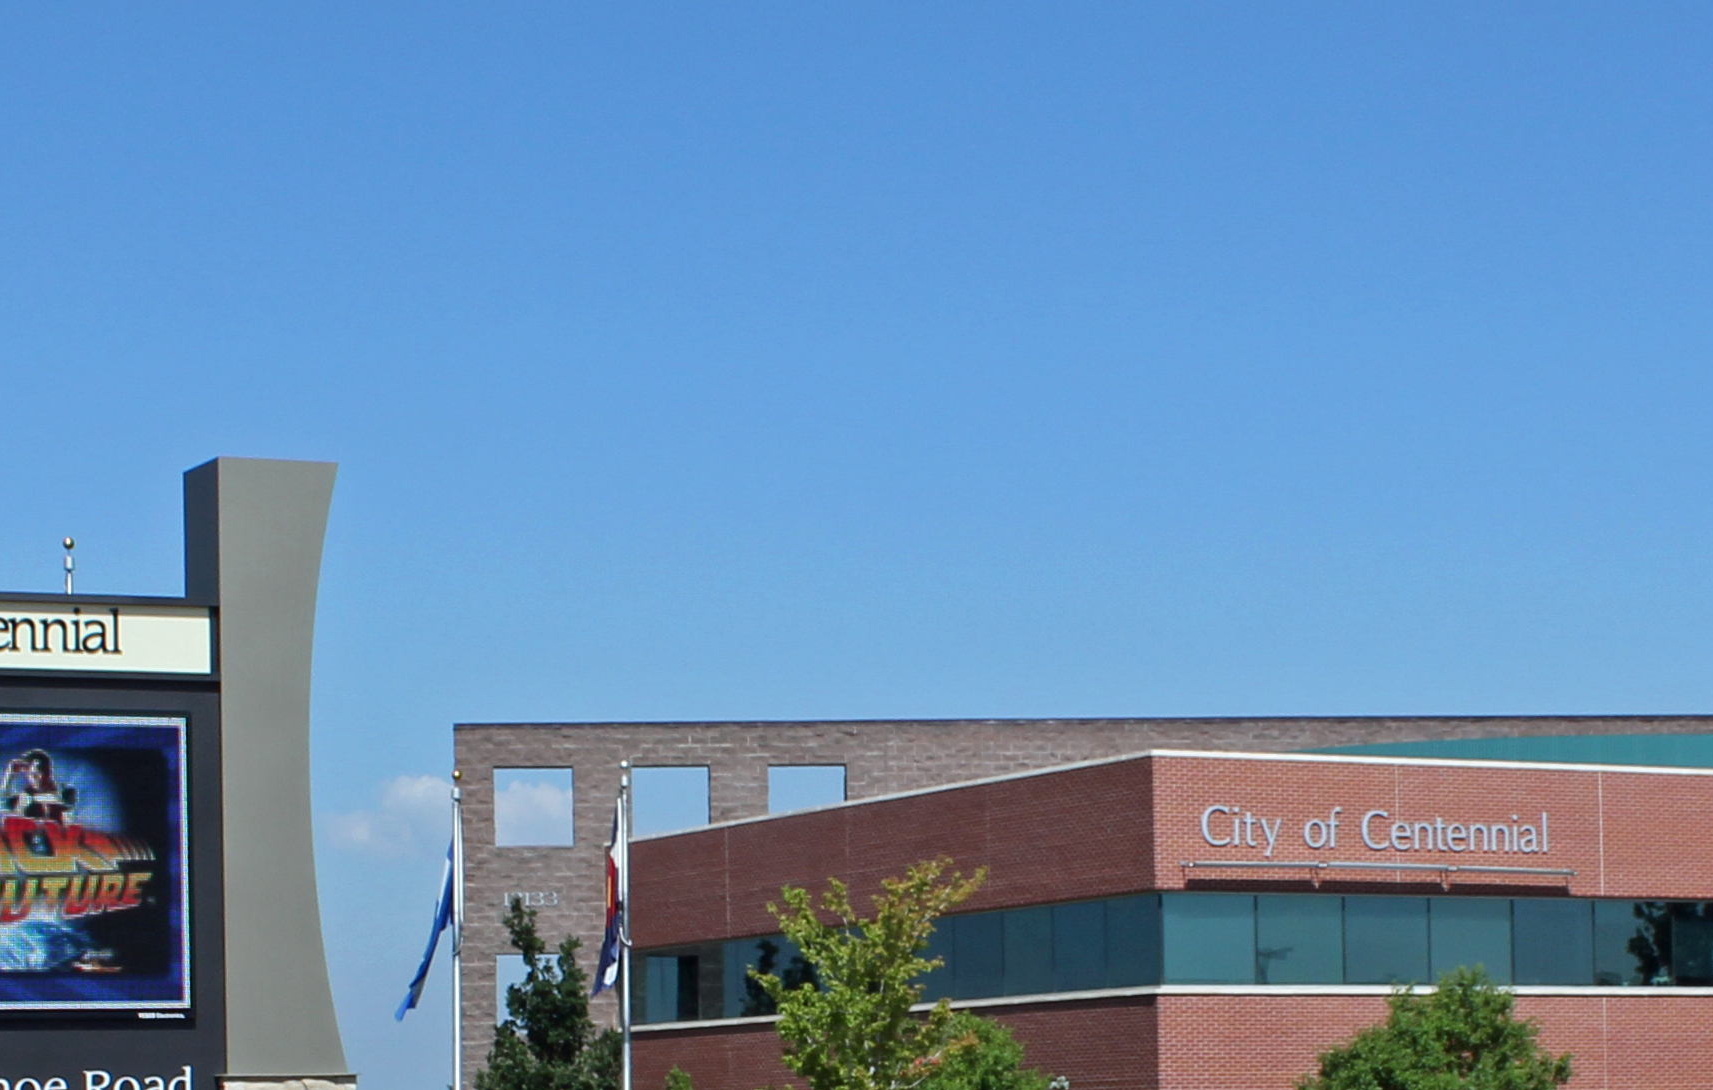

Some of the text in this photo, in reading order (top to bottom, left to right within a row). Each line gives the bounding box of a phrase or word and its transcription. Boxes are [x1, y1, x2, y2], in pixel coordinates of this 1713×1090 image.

[1200, 805, 1550, 858] City of Centennial
